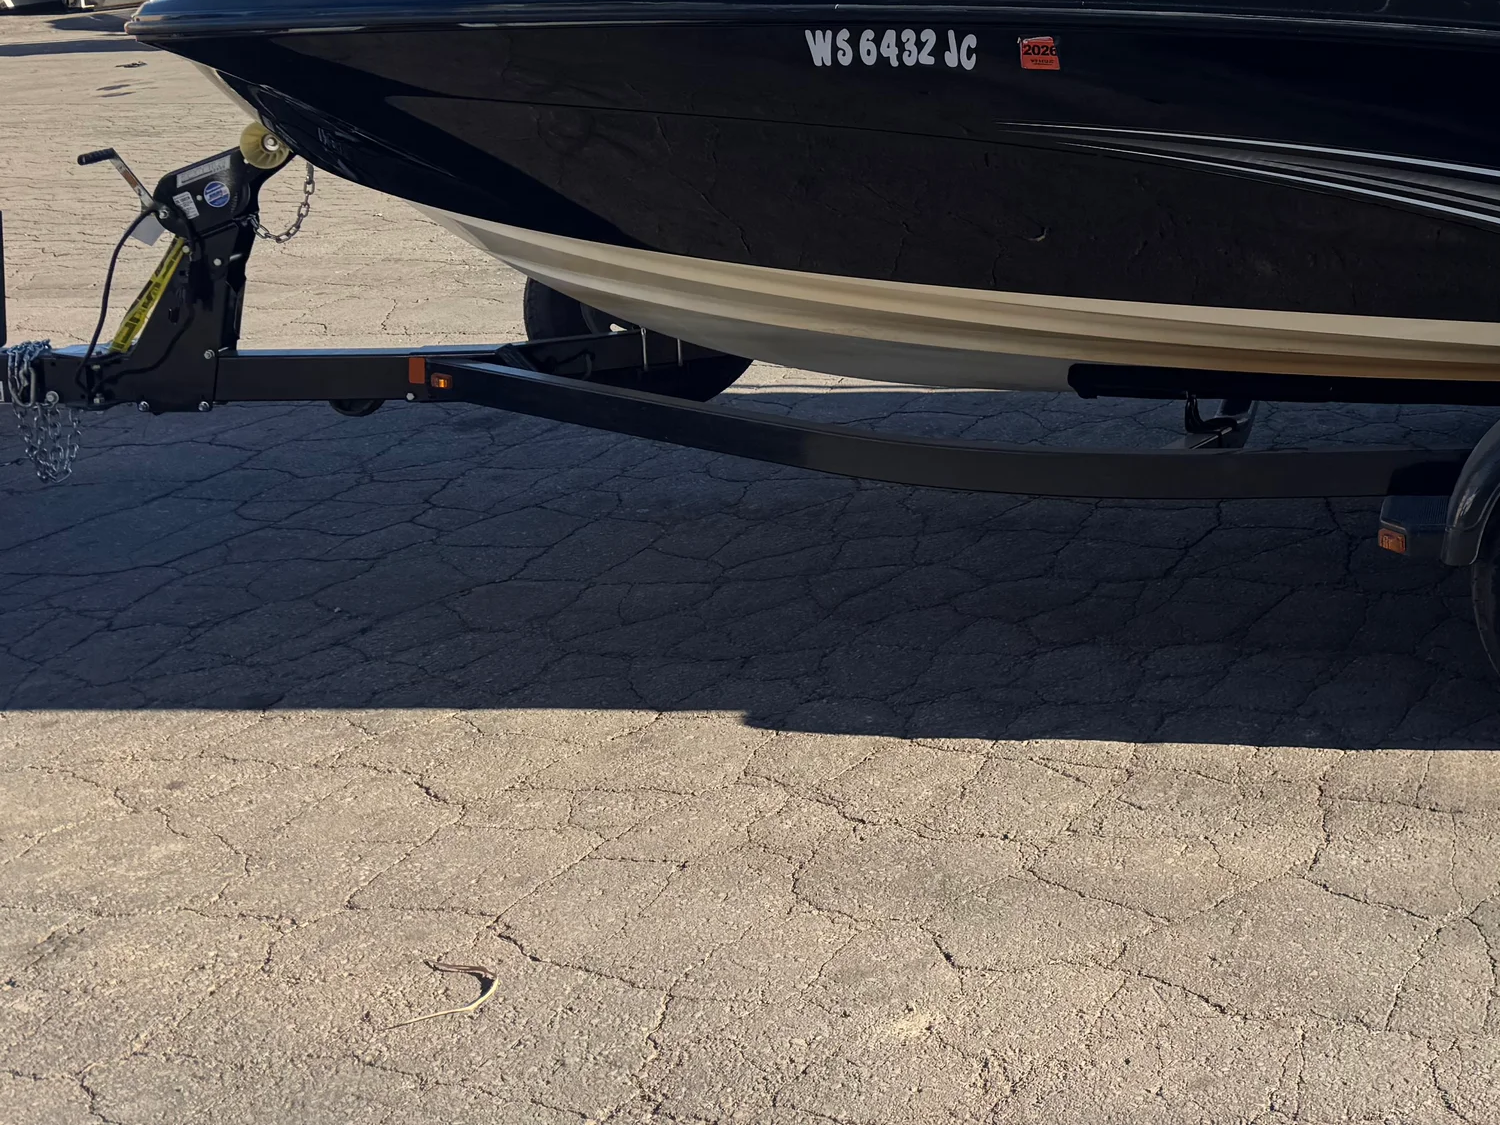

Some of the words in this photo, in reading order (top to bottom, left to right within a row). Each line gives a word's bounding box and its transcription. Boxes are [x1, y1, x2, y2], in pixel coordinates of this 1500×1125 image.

[804, 28, 853, 67] WS
[858, 28, 937, 67] 6432
[944, 29, 977, 71] JC
[1023, 44, 1057, 57] 2026
